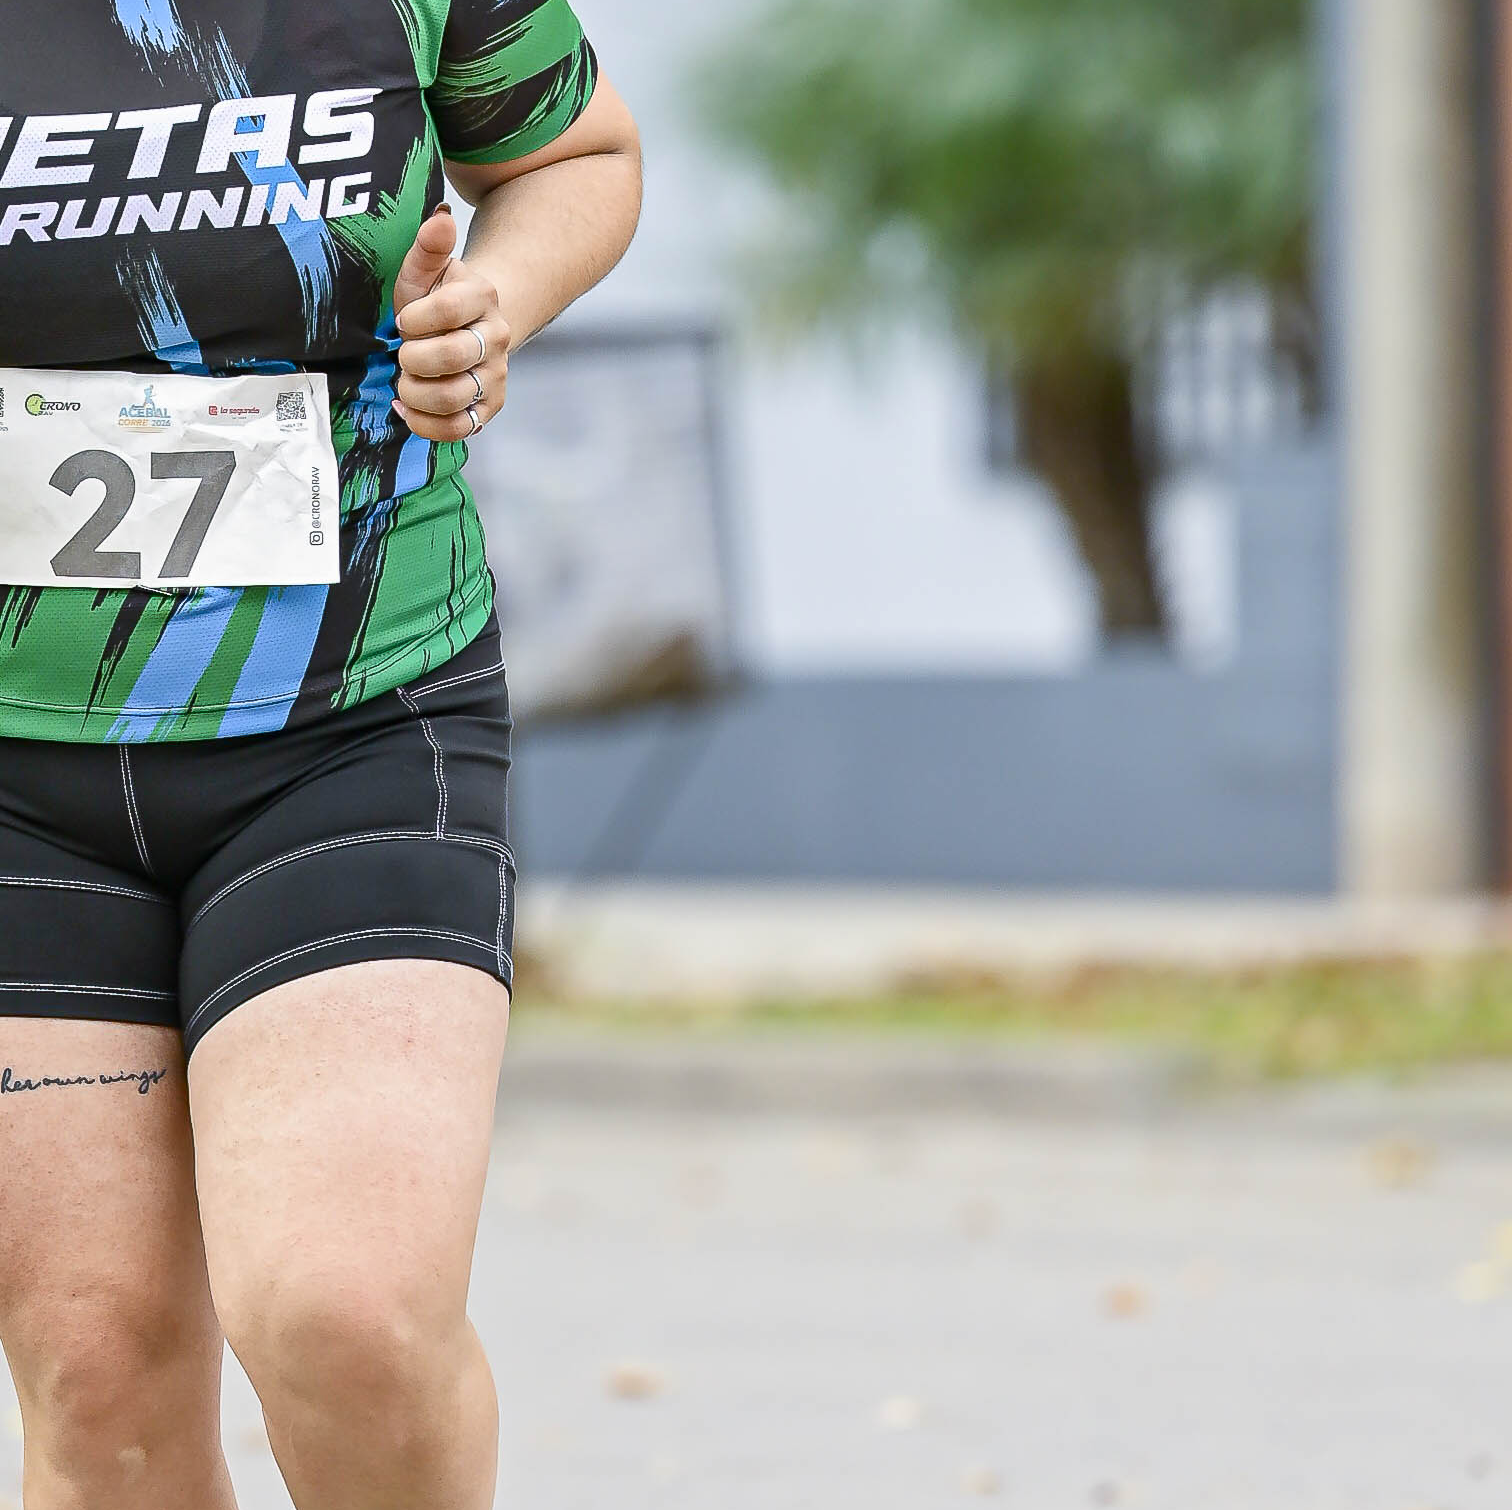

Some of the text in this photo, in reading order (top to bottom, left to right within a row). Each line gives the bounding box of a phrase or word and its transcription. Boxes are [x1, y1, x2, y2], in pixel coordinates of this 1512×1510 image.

[118, 419, 149, 427] CORRE
[48, 449, 237, 579] 27
[311, 466, 322, 529] @CRONORAV
